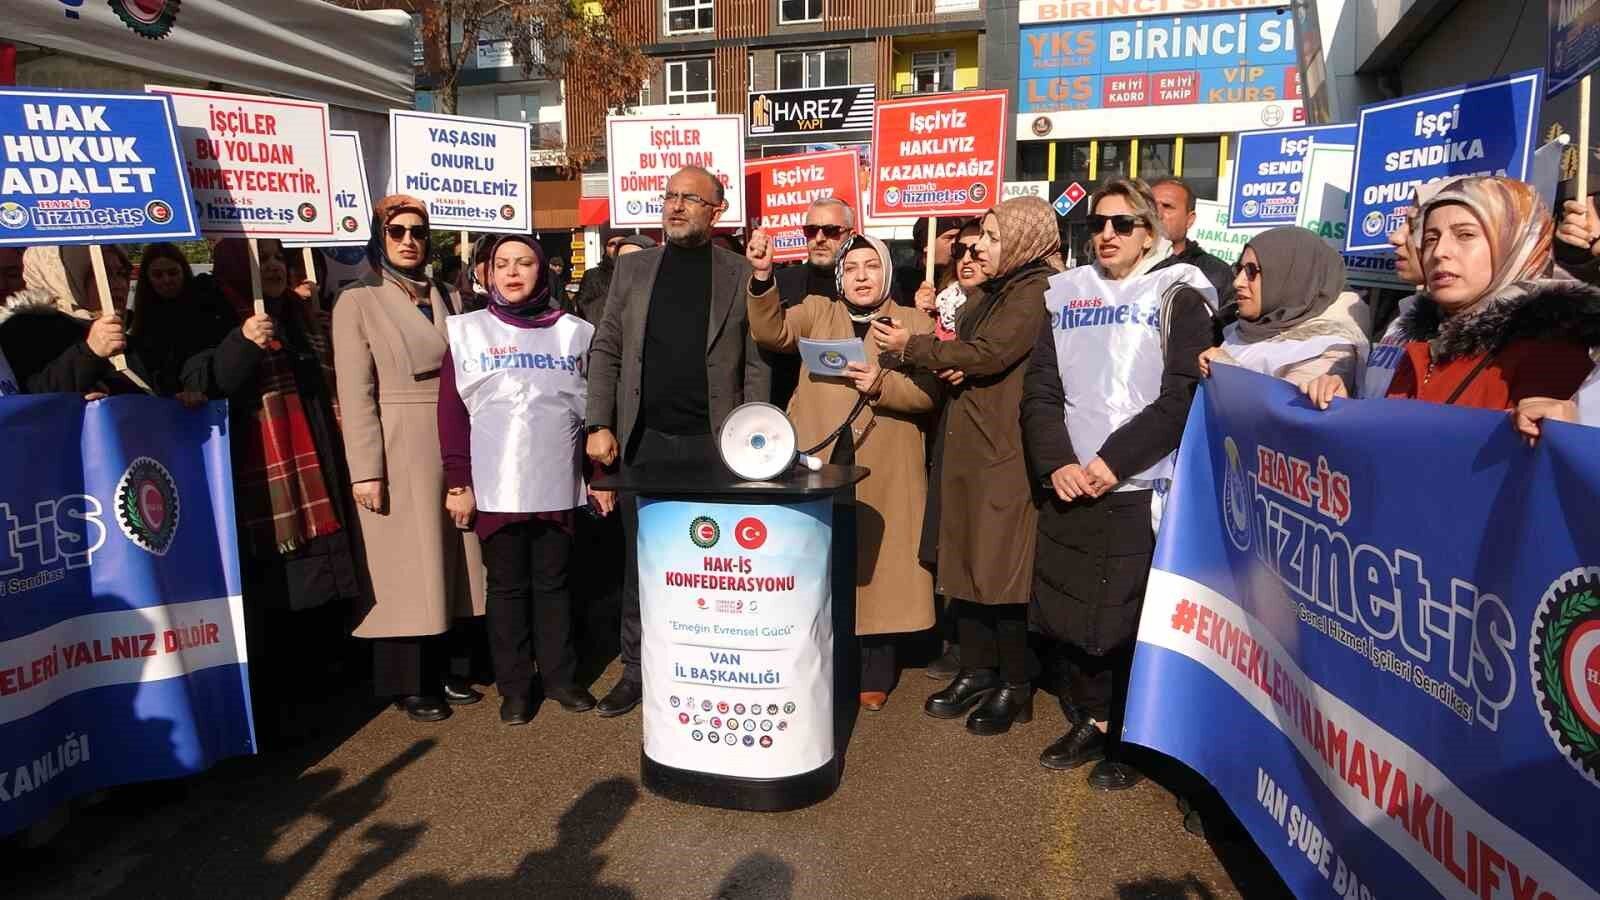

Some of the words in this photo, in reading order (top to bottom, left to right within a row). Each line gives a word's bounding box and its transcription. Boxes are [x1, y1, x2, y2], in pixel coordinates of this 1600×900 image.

[1028, 31, 1095, 57] YKS
[1109, 14, 1246, 62] BİRİNCİ
[1160, 78, 1174, 87] EN
[1177, 76, 1191, 86] İYİ
[1223, 60, 1265, 83] VİP
[1028, 76, 1093, 103] LGS
[1112, 81, 1126, 91] EN
[1128, 79, 1142, 89] İYİ
[1160, 88, 1191, 100] TAKİP
[1208, 86, 1276, 103] KURS
[1109, 92, 1144, 102] KADRO
[23, 104, 111, 133] HAK
[209, 103, 276, 136] İŞÇİLER
[774, 98, 844, 121] HAREZ
[909, 108, 968, 133] İŞÇİYİZ
[1414, 104, 1460, 139] İŞÇİ
[428, 127, 497, 148] YAŞASIN
[650, 126, 701, 150] İŞÇİLER
[899, 135, 975, 157] HAKLIYIZ
[5, 135, 142, 163] HUKUK
[196, 138, 219, 160] BU
[228, 142, 293, 165] YOLDAN
[1384, 137, 1485, 172] SENDİKA
[430, 151, 494, 172] ONURLU
[640, 153, 656, 169] BU
[660, 152, 713, 169] YOLDAN
[879, 158, 995, 182] KAZANACAĞIZ
[1258, 160, 1304, 176] SEND
[1, 168, 156, 194] ADALET
[189, 163, 321, 195] ÖNMEYECEKTİR.
[406, 175, 518, 197] MÜCADELEMİZ
[772, 165, 825, 187] İŞÇİYİZ
[766, 188, 834, 207] HAKLIYIZ
[1242, 181, 1287, 197] OMUZ
[208, 203, 294, 223] hizmet-iş
[430, 203, 497, 220] hizmet-iş
[1197, 228, 1252, 245] HAKLAR
[480, 352, 577, 375] hizmet-iş
[1257, 445, 1351, 526] HAK-İŞ
[703, 556, 752, 574] HAK-İŞ
[666, 572, 795, 592] KONFEDERASYONU
[1248, 470, 1516, 731] hizmet-iş
[669, 620, 710, 634] "Emeğin
[714, 625, 758, 636] Evrensel
[63, 633, 157, 669] YALNIZ
[710, 652, 741, 665] VAN
[675, 663, 687, 678] İL
[691, 667, 780, 684] BAŞKANLIĞI
[1328, 618, 1368, 658] Hizmet
[1413, 664, 1474, 725] Sendikası
[1257, 767, 1288, 827] VAN
[1288, 805, 1334, 880] ŞUBE
